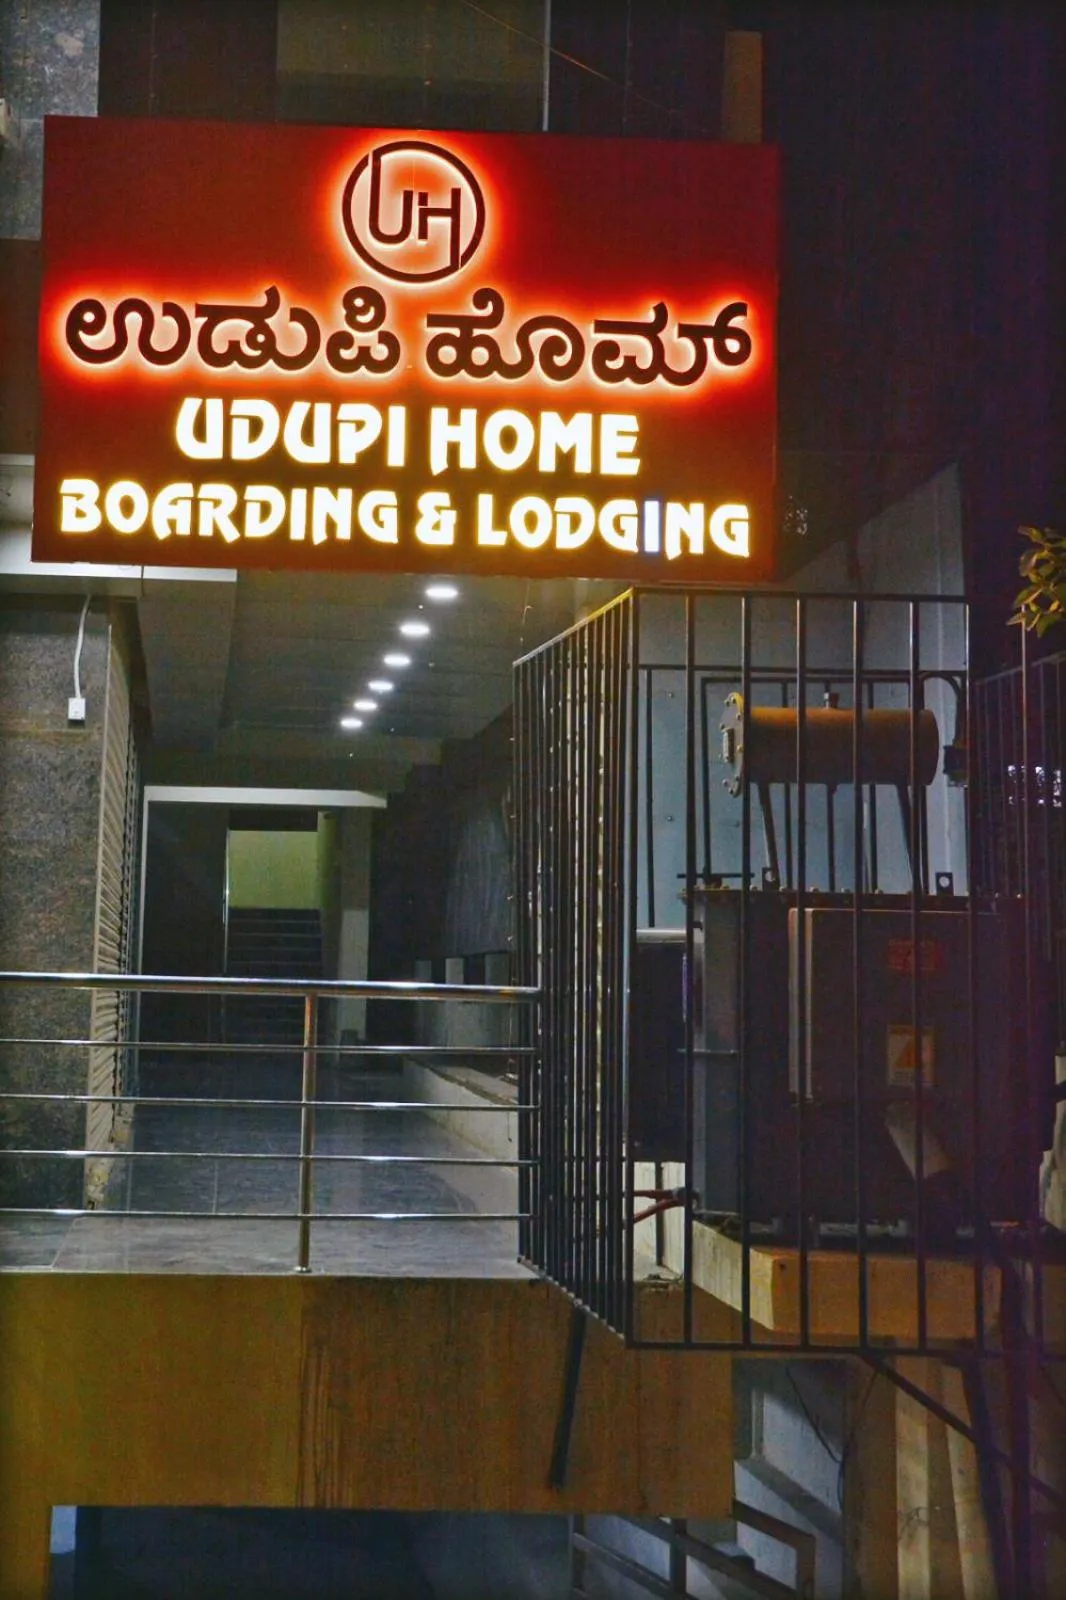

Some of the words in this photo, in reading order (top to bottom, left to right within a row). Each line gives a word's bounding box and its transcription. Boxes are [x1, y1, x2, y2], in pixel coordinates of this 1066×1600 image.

[66, 285, 401, 374] ಉಡುಪಿ
[176, 398, 405, 468] UDUPI
[429, 407, 640, 475] HOME
[60, 479, 399, 545] BOARDING
[414, 491, 457, 546] &
[477, 494, 750, 560] LODGING
